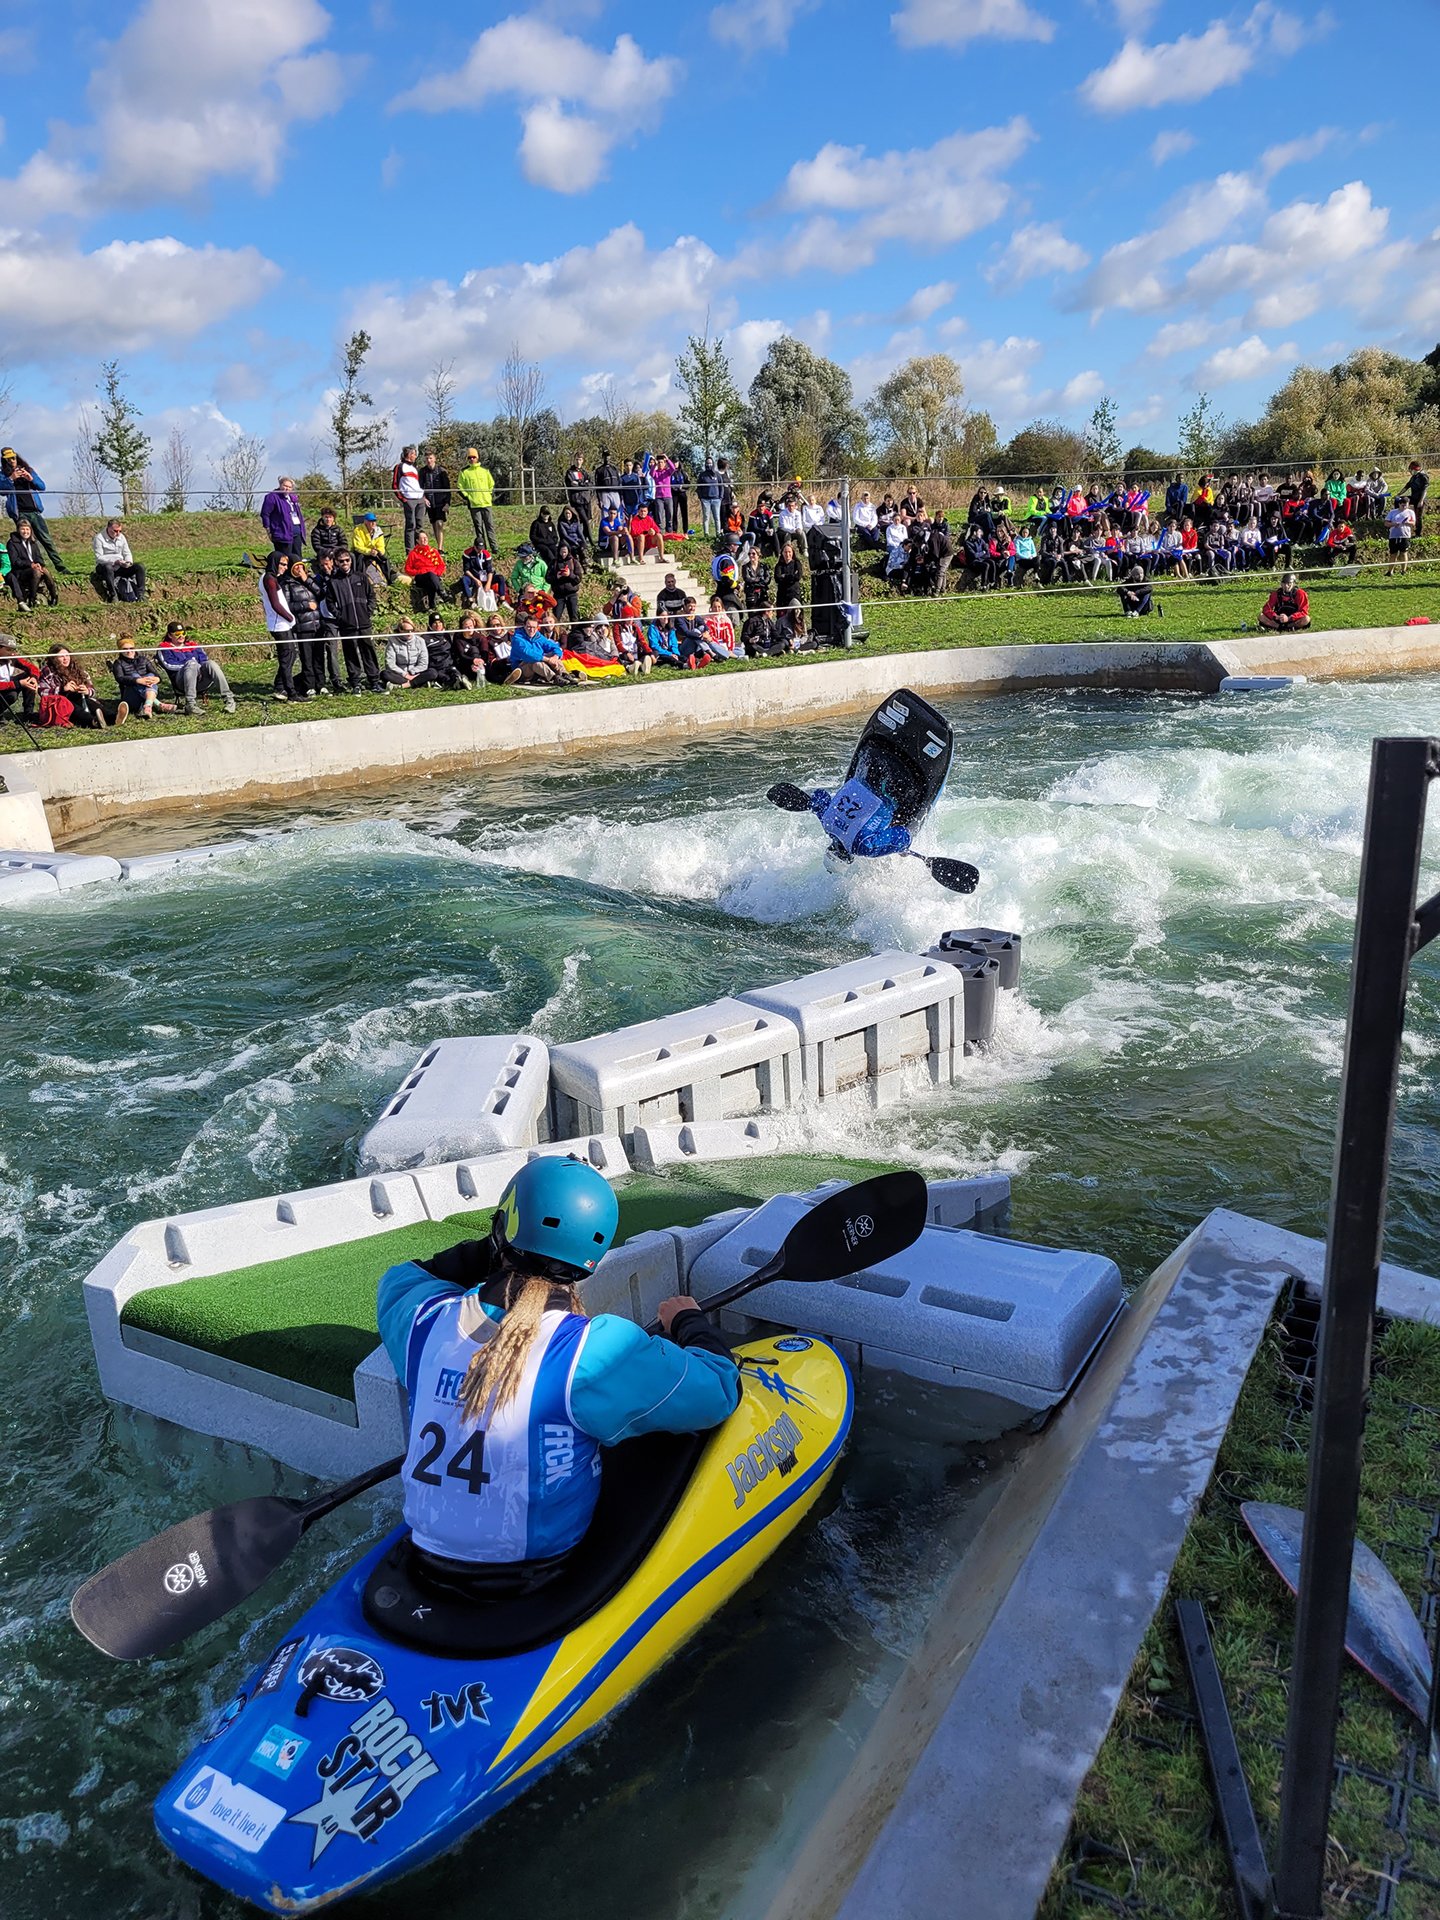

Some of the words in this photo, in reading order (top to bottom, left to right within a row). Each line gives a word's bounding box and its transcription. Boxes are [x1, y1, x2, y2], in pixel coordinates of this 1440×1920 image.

[435, 1368, 468, 1402] FFC
[411, 1421, 491, 1496] 24
[544, 1424, 575, 1486] FFCK
[725, 1411, 804, 1510] Jackson
[189, 1550, 209, 1588] WERNER
[350, 1697, 440, 1801] ROCK
[210, 1797, 233, 1822] love
[231, 1808, 242, 1826] it
[237, 1814, 257, 1837] live
[254, 1825, 268, 1841] it
[320, 1814, 339, 1835] 4.0
